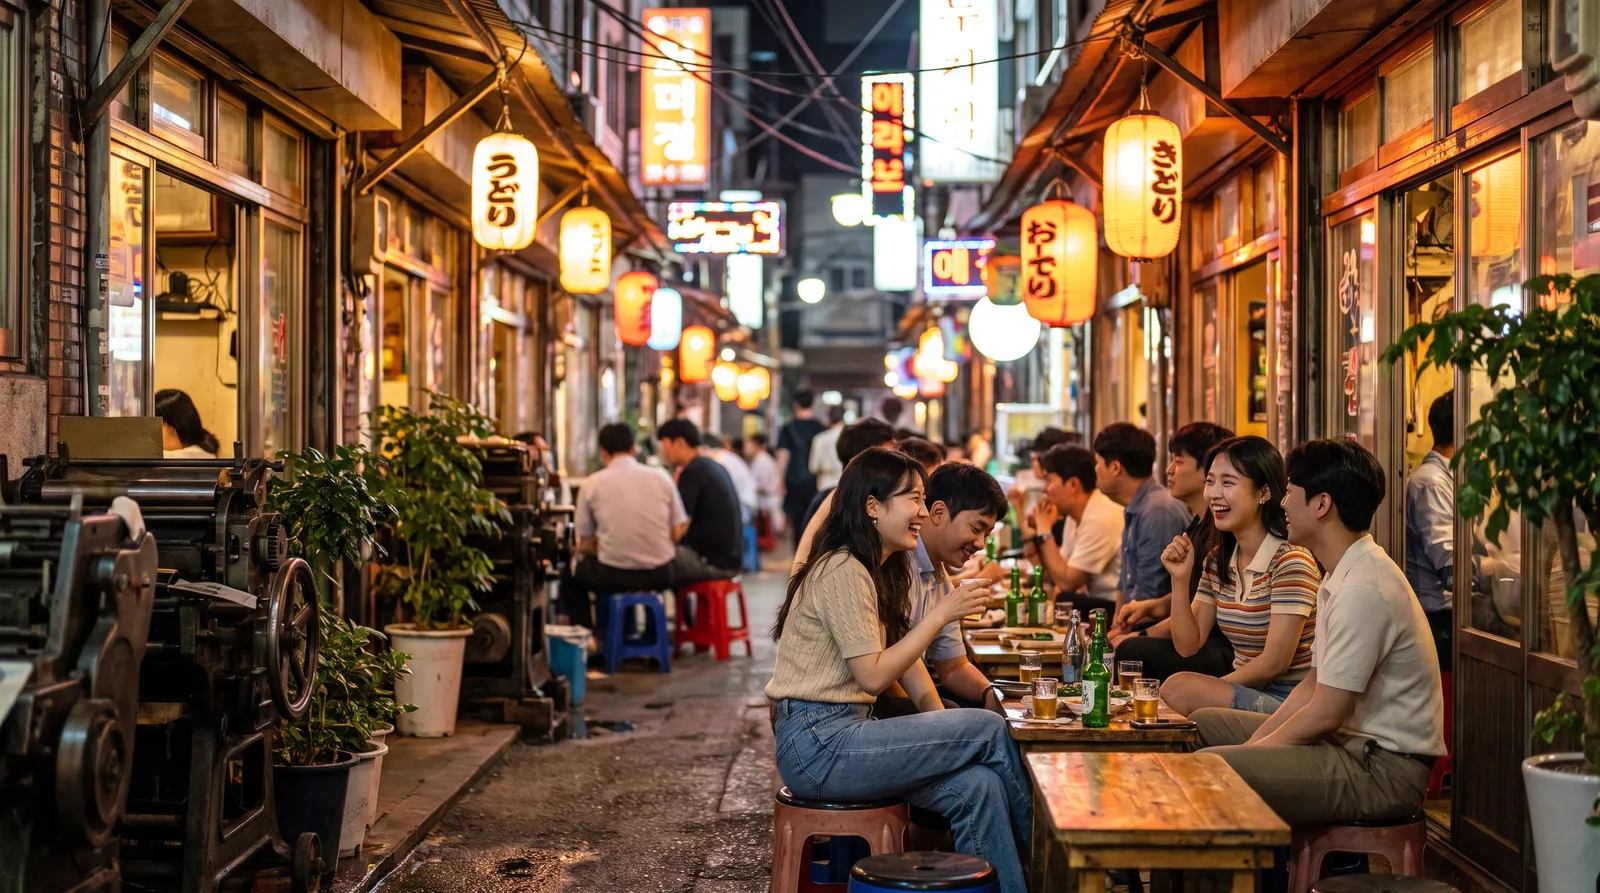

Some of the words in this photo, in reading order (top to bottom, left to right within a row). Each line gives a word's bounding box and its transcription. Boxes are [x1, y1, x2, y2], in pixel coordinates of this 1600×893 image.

[487, 154, 519, 227] うどり
[1152, 140, 1178, 224] きどり
